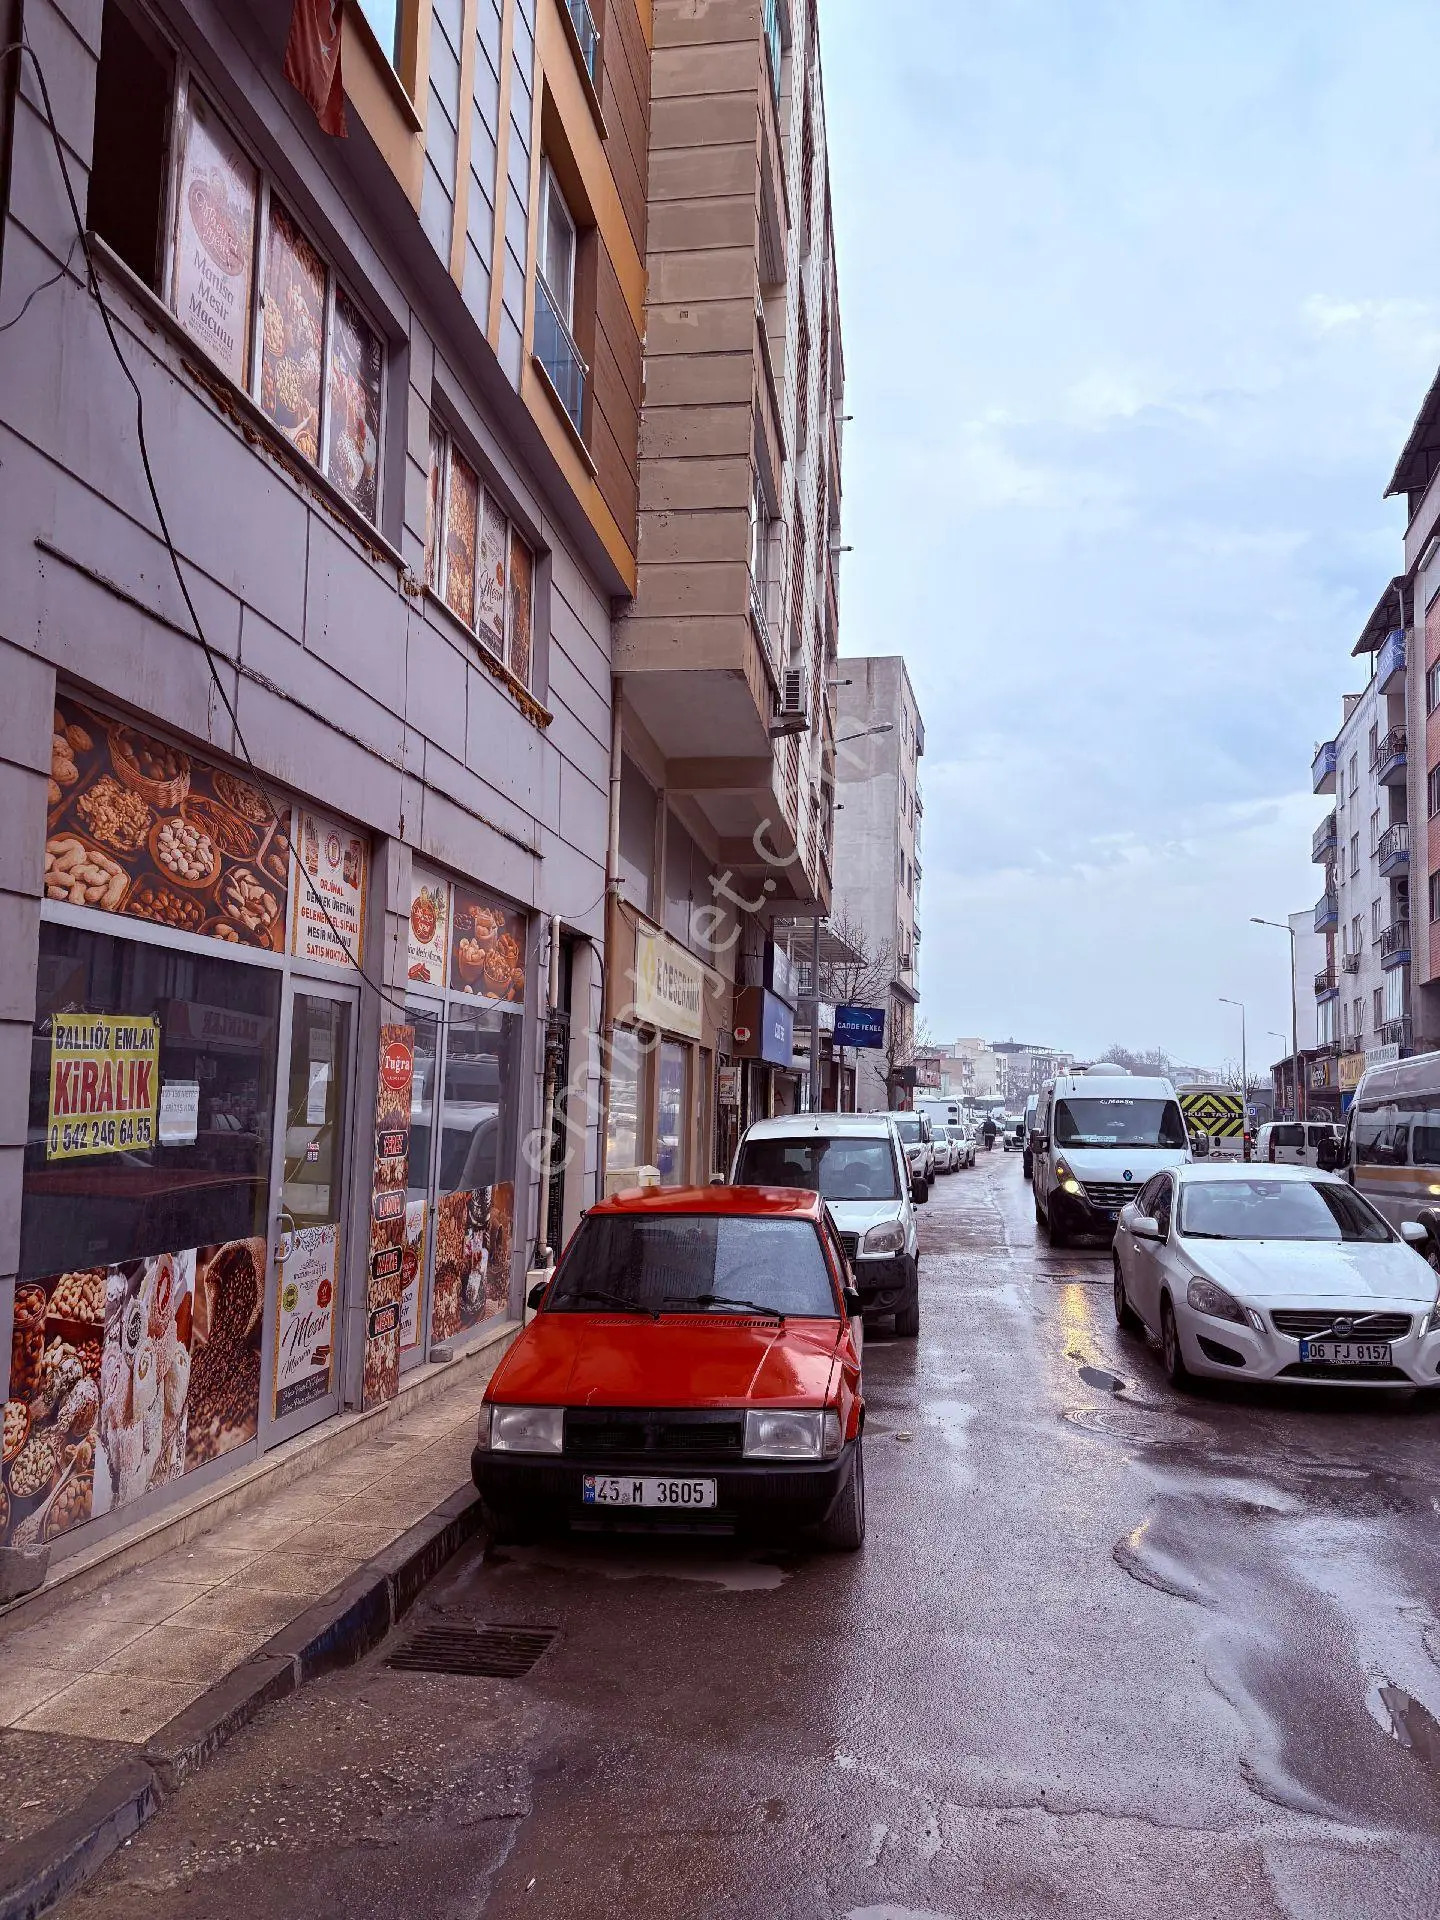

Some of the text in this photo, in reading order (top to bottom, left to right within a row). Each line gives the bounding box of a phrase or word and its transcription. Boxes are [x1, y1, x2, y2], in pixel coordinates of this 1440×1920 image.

[194, 249, 234, 305] Manisa
[198, 279, 230, 321] Mesir
[188, 293, 234, 350] Macunu
[56, 1021, 155, 1050] BALLIÖZ EMLAK
[385, 1055, 410, 1073] Tuğra
[51, 1117, 151, 1152] 0 542 246 64 55
[1310, 1343, 1388, 1360] 06 FJ 8157
[597, 1480, 704, 1503] 45 M 3605
